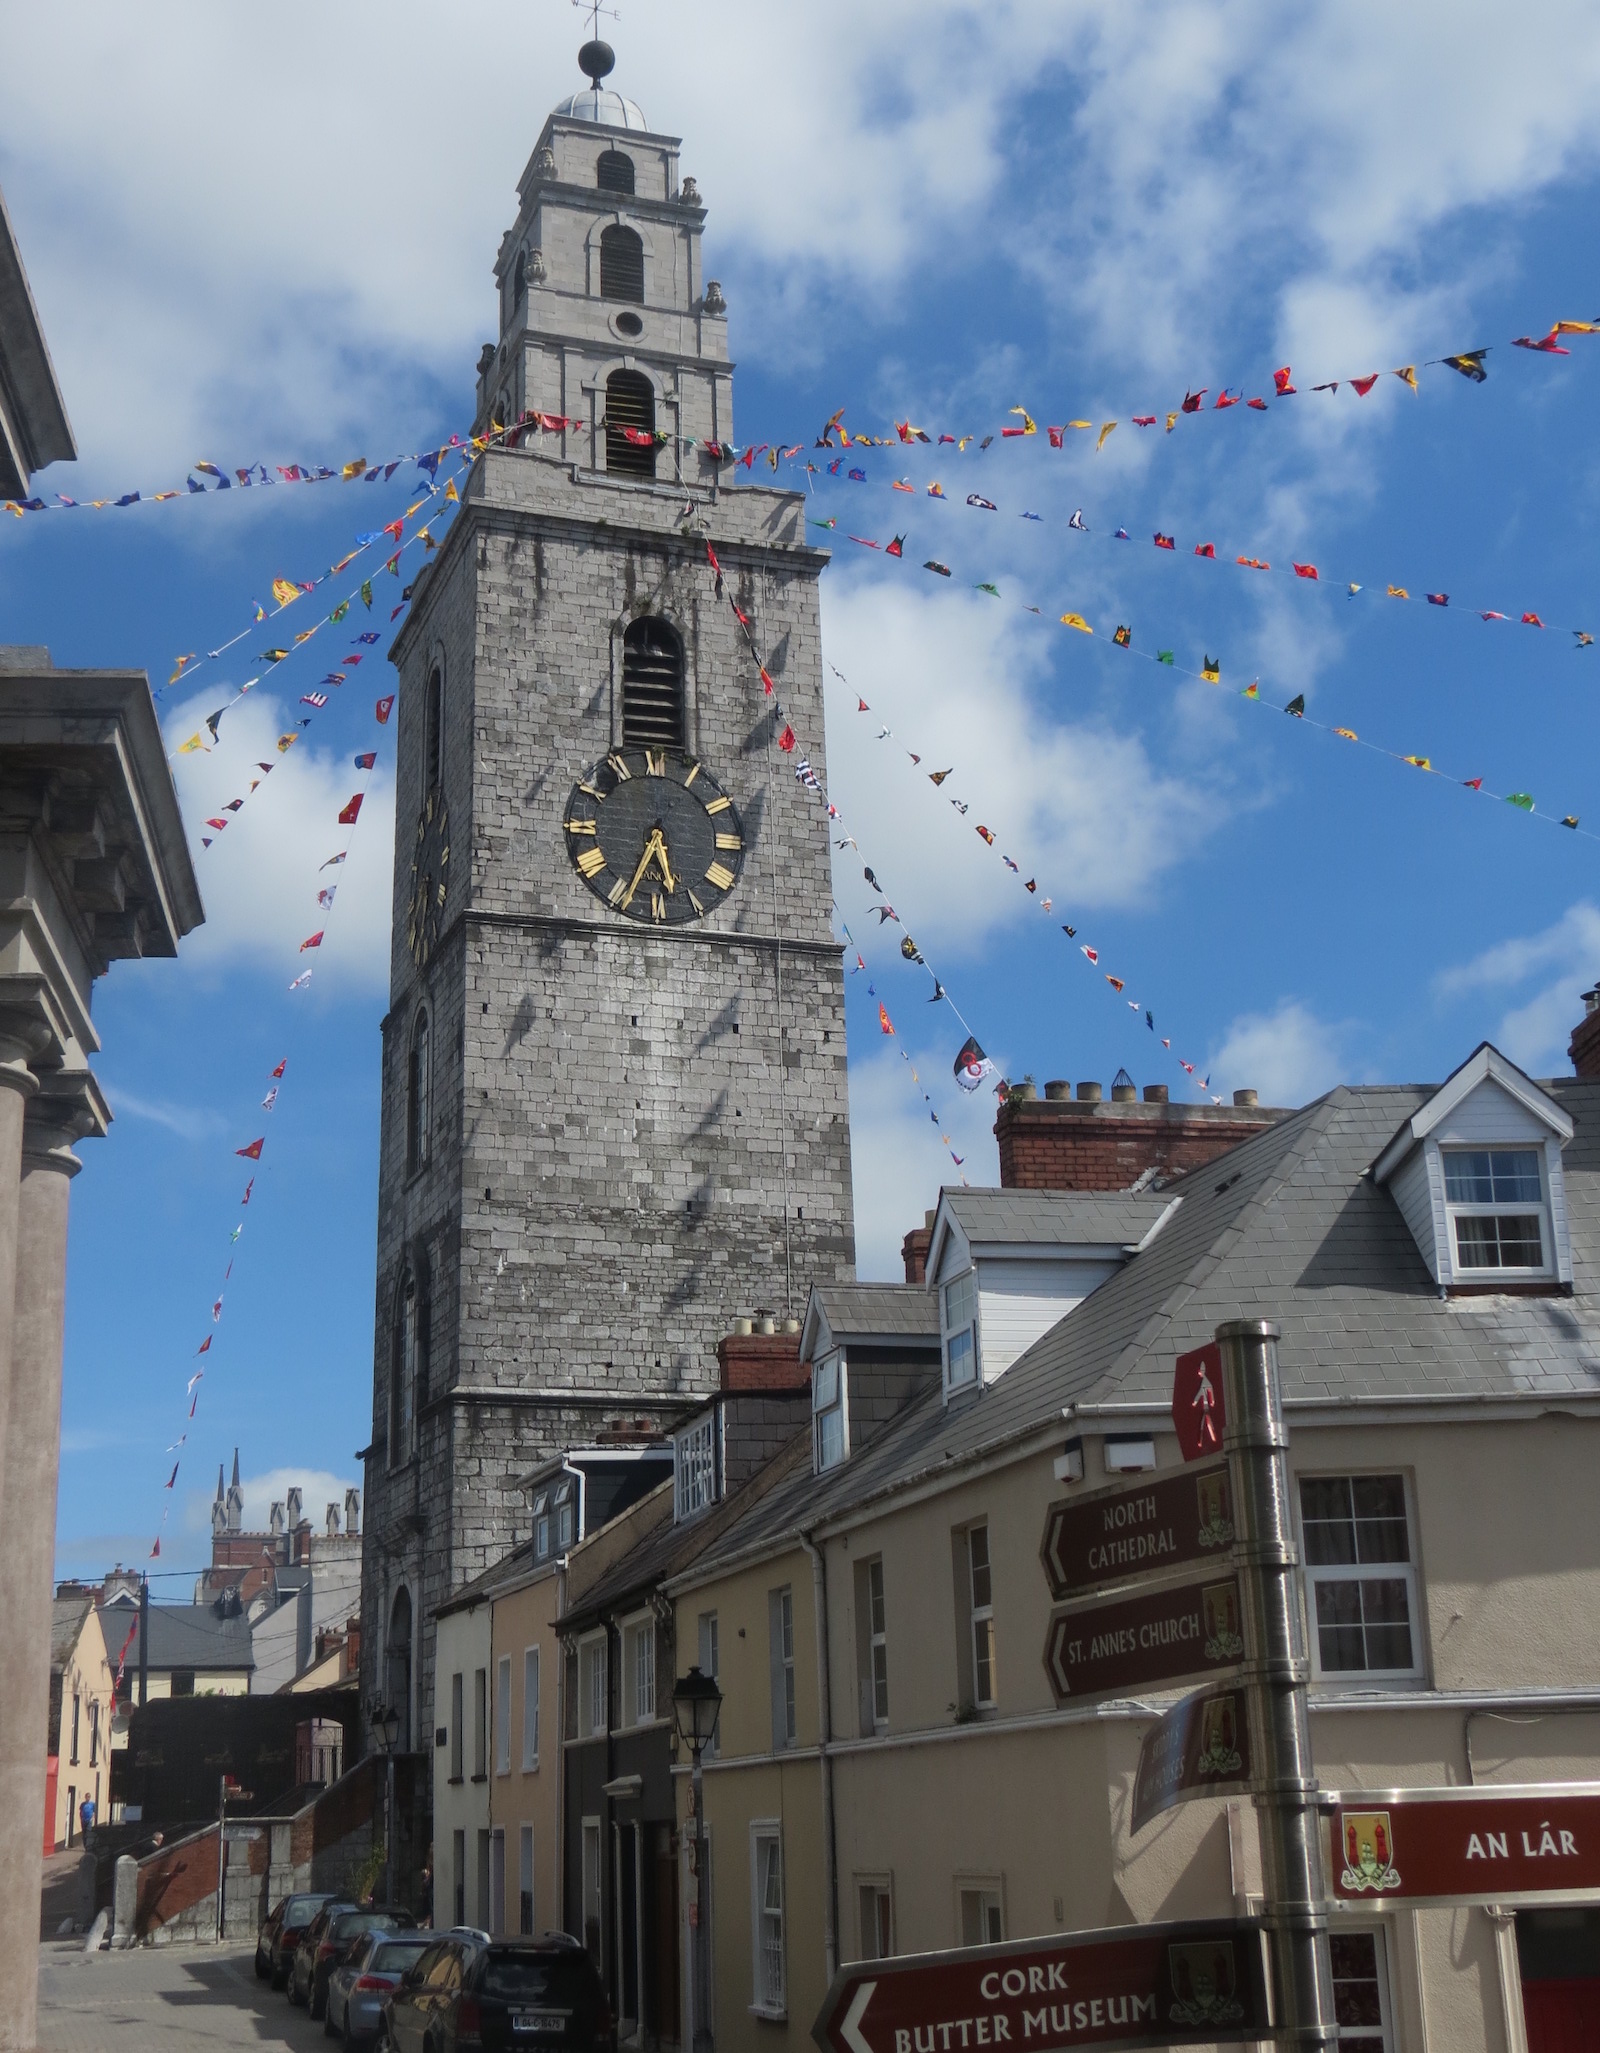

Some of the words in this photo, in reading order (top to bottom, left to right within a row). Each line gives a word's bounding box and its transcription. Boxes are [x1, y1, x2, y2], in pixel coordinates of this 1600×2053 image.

[1103, 1496, 1157, 1531] NORTH
[1088, 1528, 1177, 1570] CATHEDRAL
[1068, 1640, 1087, 1665] ST.
[1090, 1628, 1136, 1660] ANNE'S
[1139, 1613, 1200, 1649] CHURCH
[1465, 1832, 1509, 1859] AN
[1521, 1820, 1579, 1857] LÁR
[980, 1961, 1069, 2000] CORK
[894, 2014, 1013, 2053] BUTTER
[1021, 1993, 1158, 2038] MUSEUM
